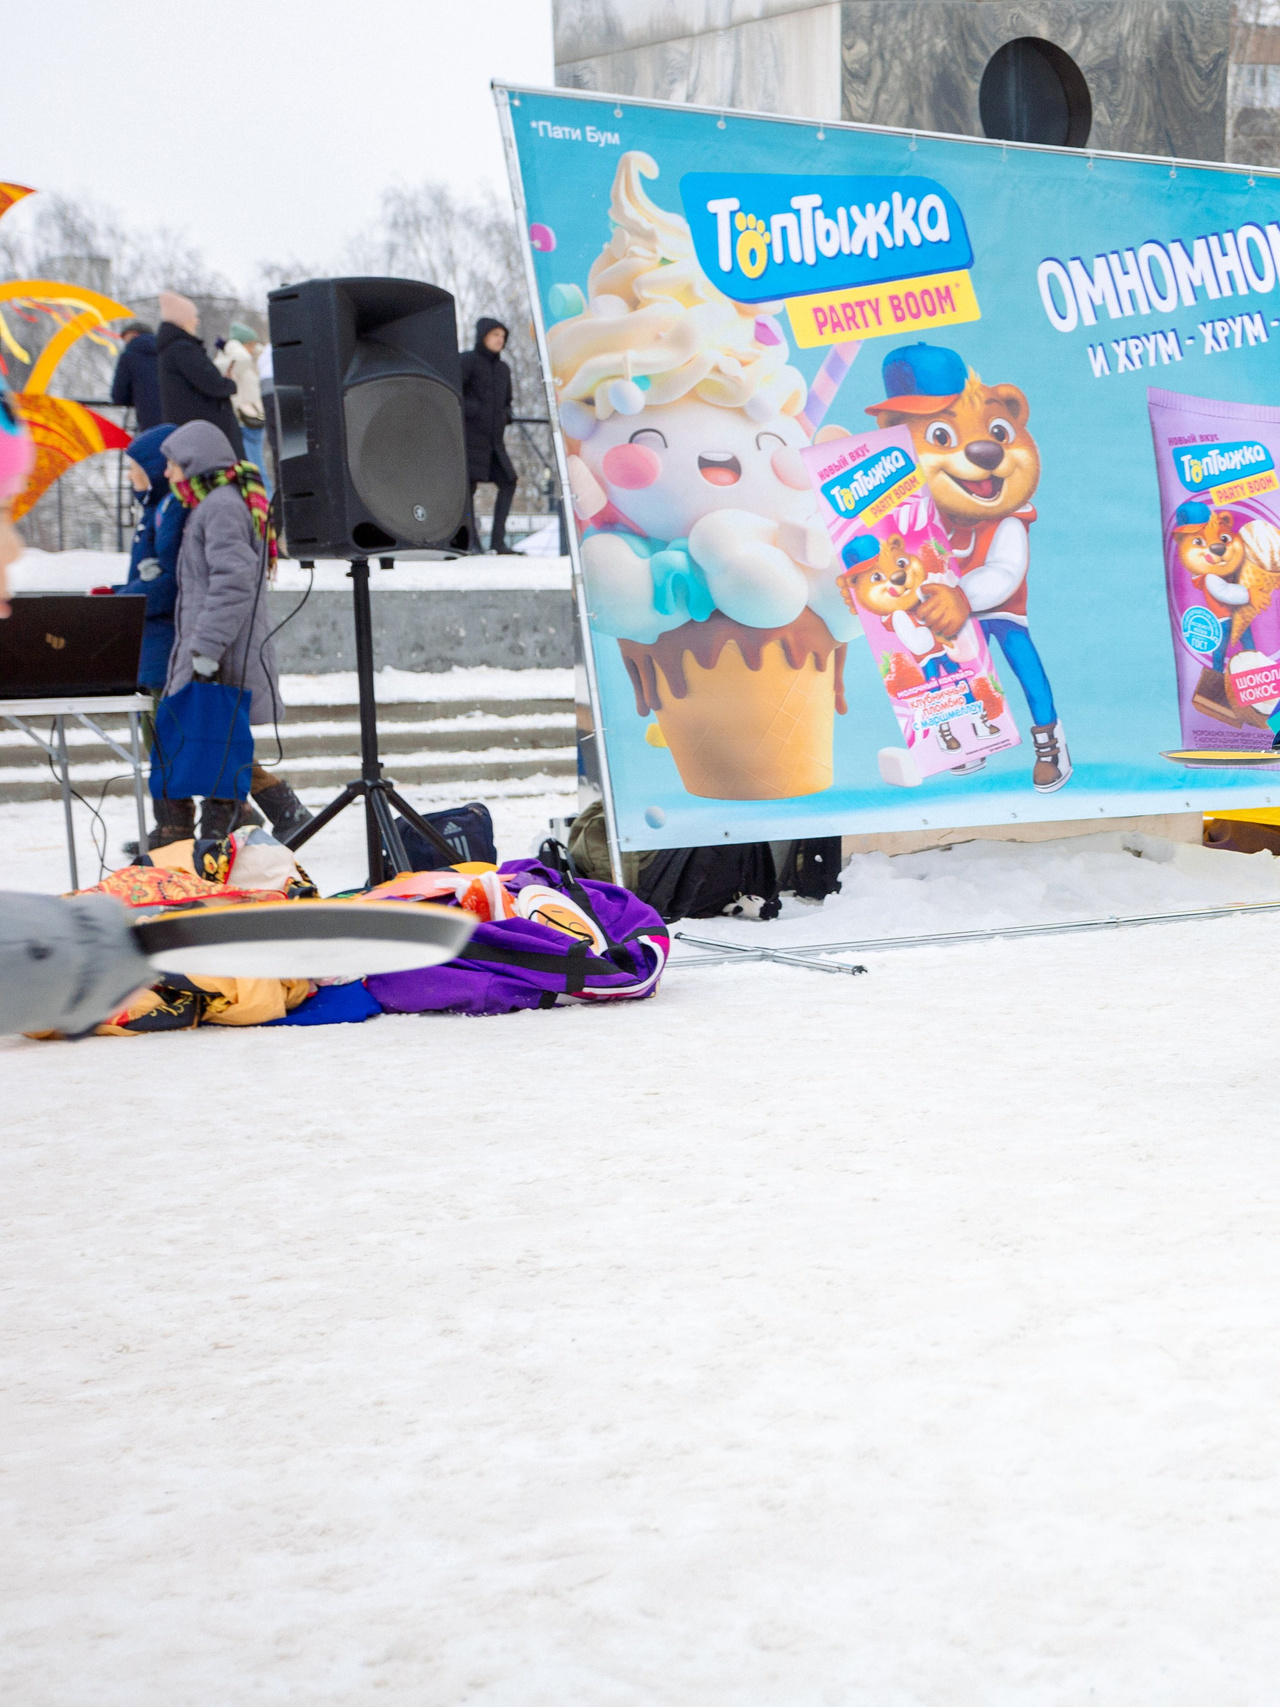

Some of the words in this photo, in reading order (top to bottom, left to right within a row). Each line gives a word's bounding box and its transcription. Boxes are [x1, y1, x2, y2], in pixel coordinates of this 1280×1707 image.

[585, 125, 620, 147] Бум
[812, 296, 882, 336] PARTY
[1088, 343, 1110, 378] И
[1111, 329, 1183, 374] ХРУМ
[1198, 311, 1268, 355] ХРУМ
[1168, 434, 1197, 446] НОВЫЙ
[1199, 434, 1219, 442] ВКУС
[818, 454, 849, 481] НОВЫЙ
[849, 444, 870, 462] ВКУС
[870, 493, 895, 518] PARTY
[892, 475, 920, 500] BOOM
[1216, 484, 1246, 503] PARTY
[1247, 476, 1276, 493] BOOM
[1191, 638, 1208, 650] ГОСТ
[910, 682, 966, 709] клубничный
[1239, 683, 1279, 703] КОКОС
[921, 702, 982, 727] маршмеллоу
[922, 697, 965, 716] пломбир
